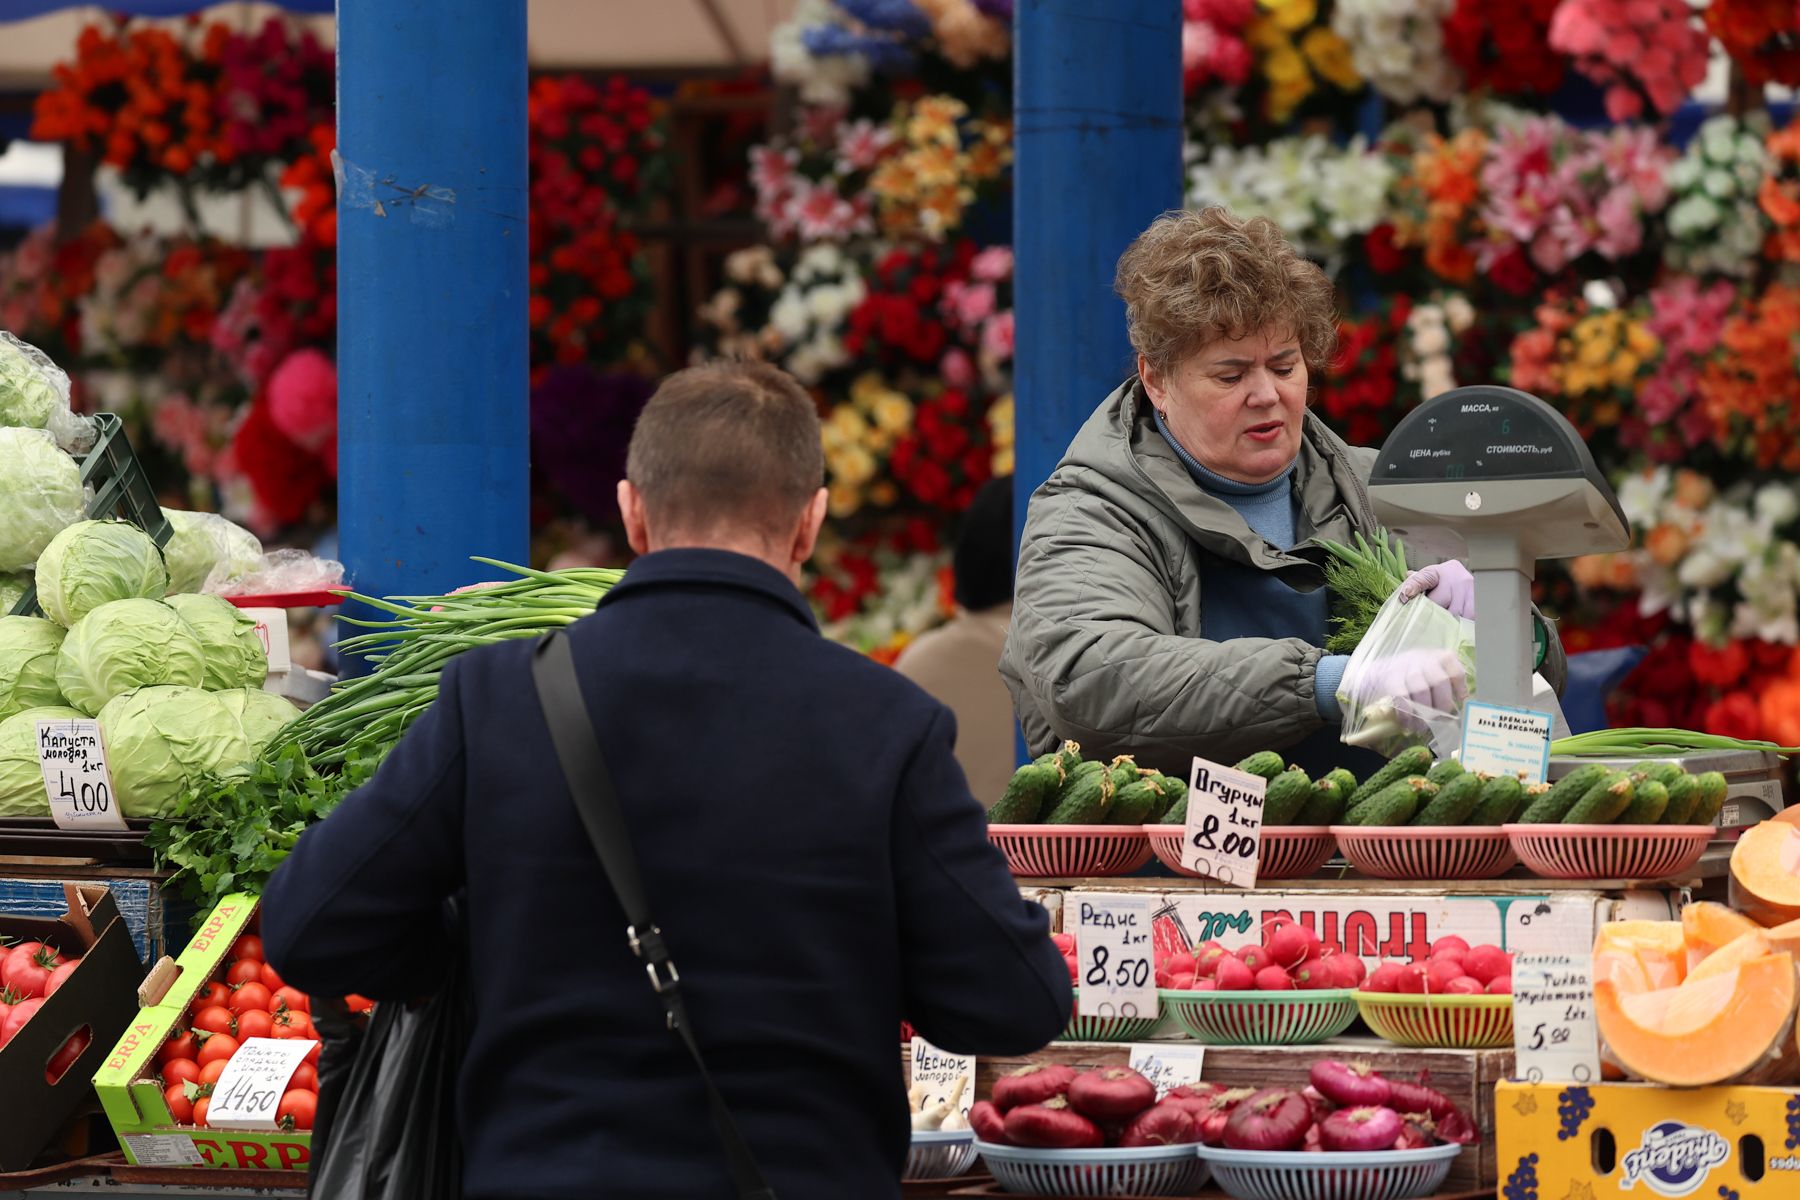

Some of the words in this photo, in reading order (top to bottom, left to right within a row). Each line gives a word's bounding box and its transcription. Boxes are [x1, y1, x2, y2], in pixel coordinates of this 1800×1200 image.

[1410, 449, 1431, 459] ЦЕНА
[60, 770, 109, 812] 4.00
[1195, 767, 1263, 808] Огурцы
[1193, 814, 1256, 858] 8.00
[191, 904, 237, 952] ERPA
[1081, 902, 1137, 929] Редис
[107, 1022, 153, 1071] ERPA
[916, 1044, 968, 1071] Чеснок
[1625, 1136, 1728, 1179] Trident
